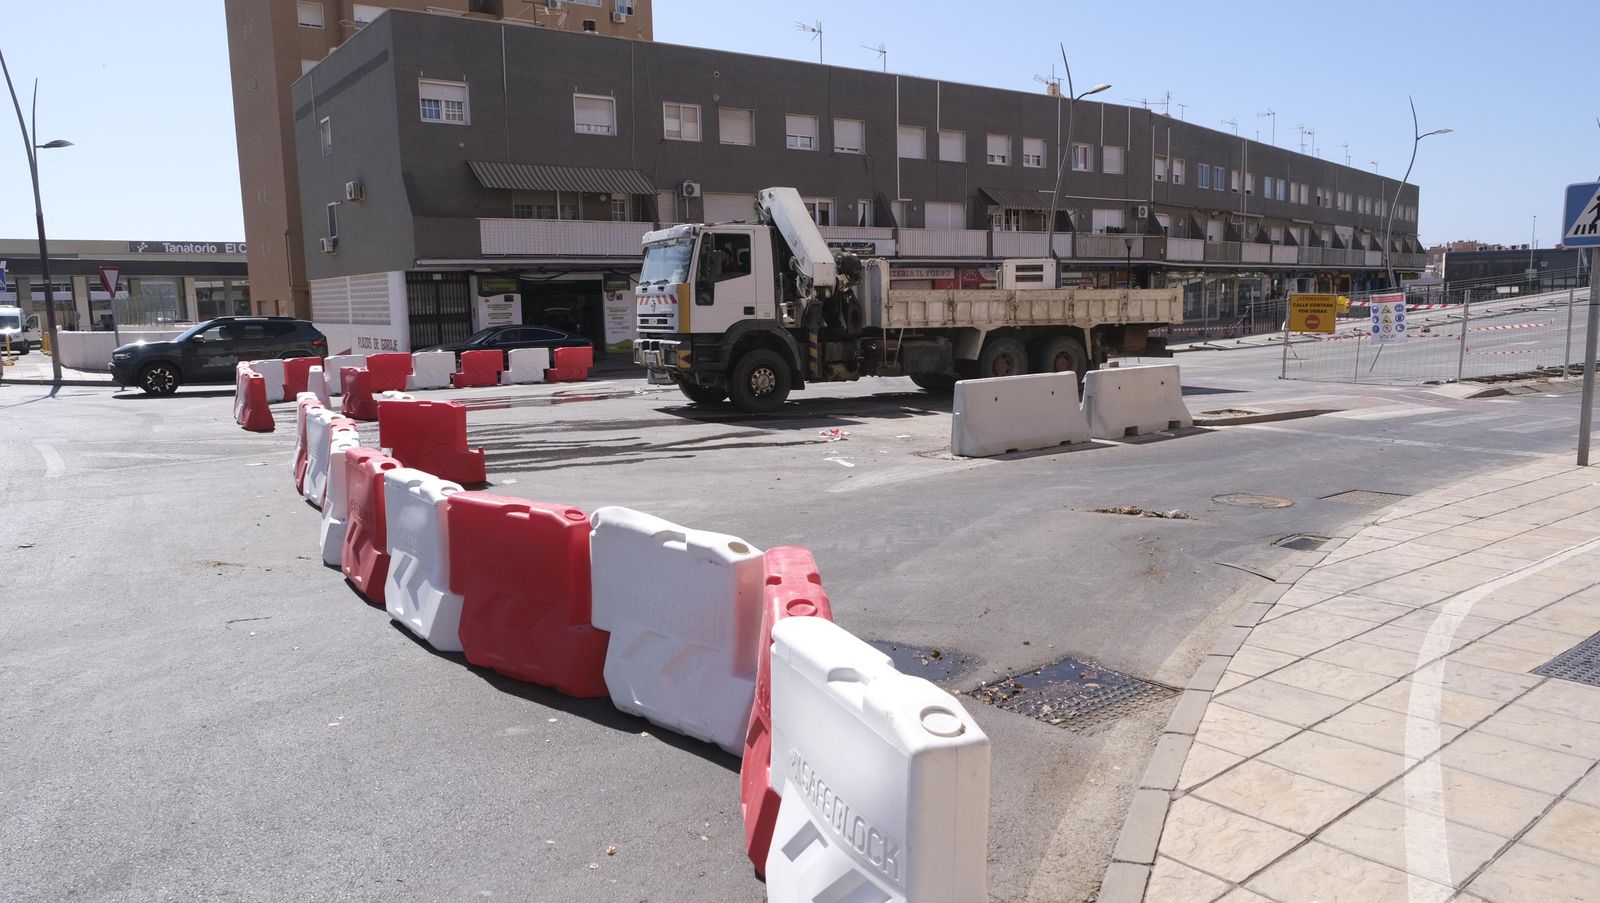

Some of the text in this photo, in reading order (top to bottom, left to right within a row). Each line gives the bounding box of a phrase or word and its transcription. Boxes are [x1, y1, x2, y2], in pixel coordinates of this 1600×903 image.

[162, 241, 217, 253] Tanatorio
[225, 243, 237, 254] El
[373, 337, 380, 350] DE
